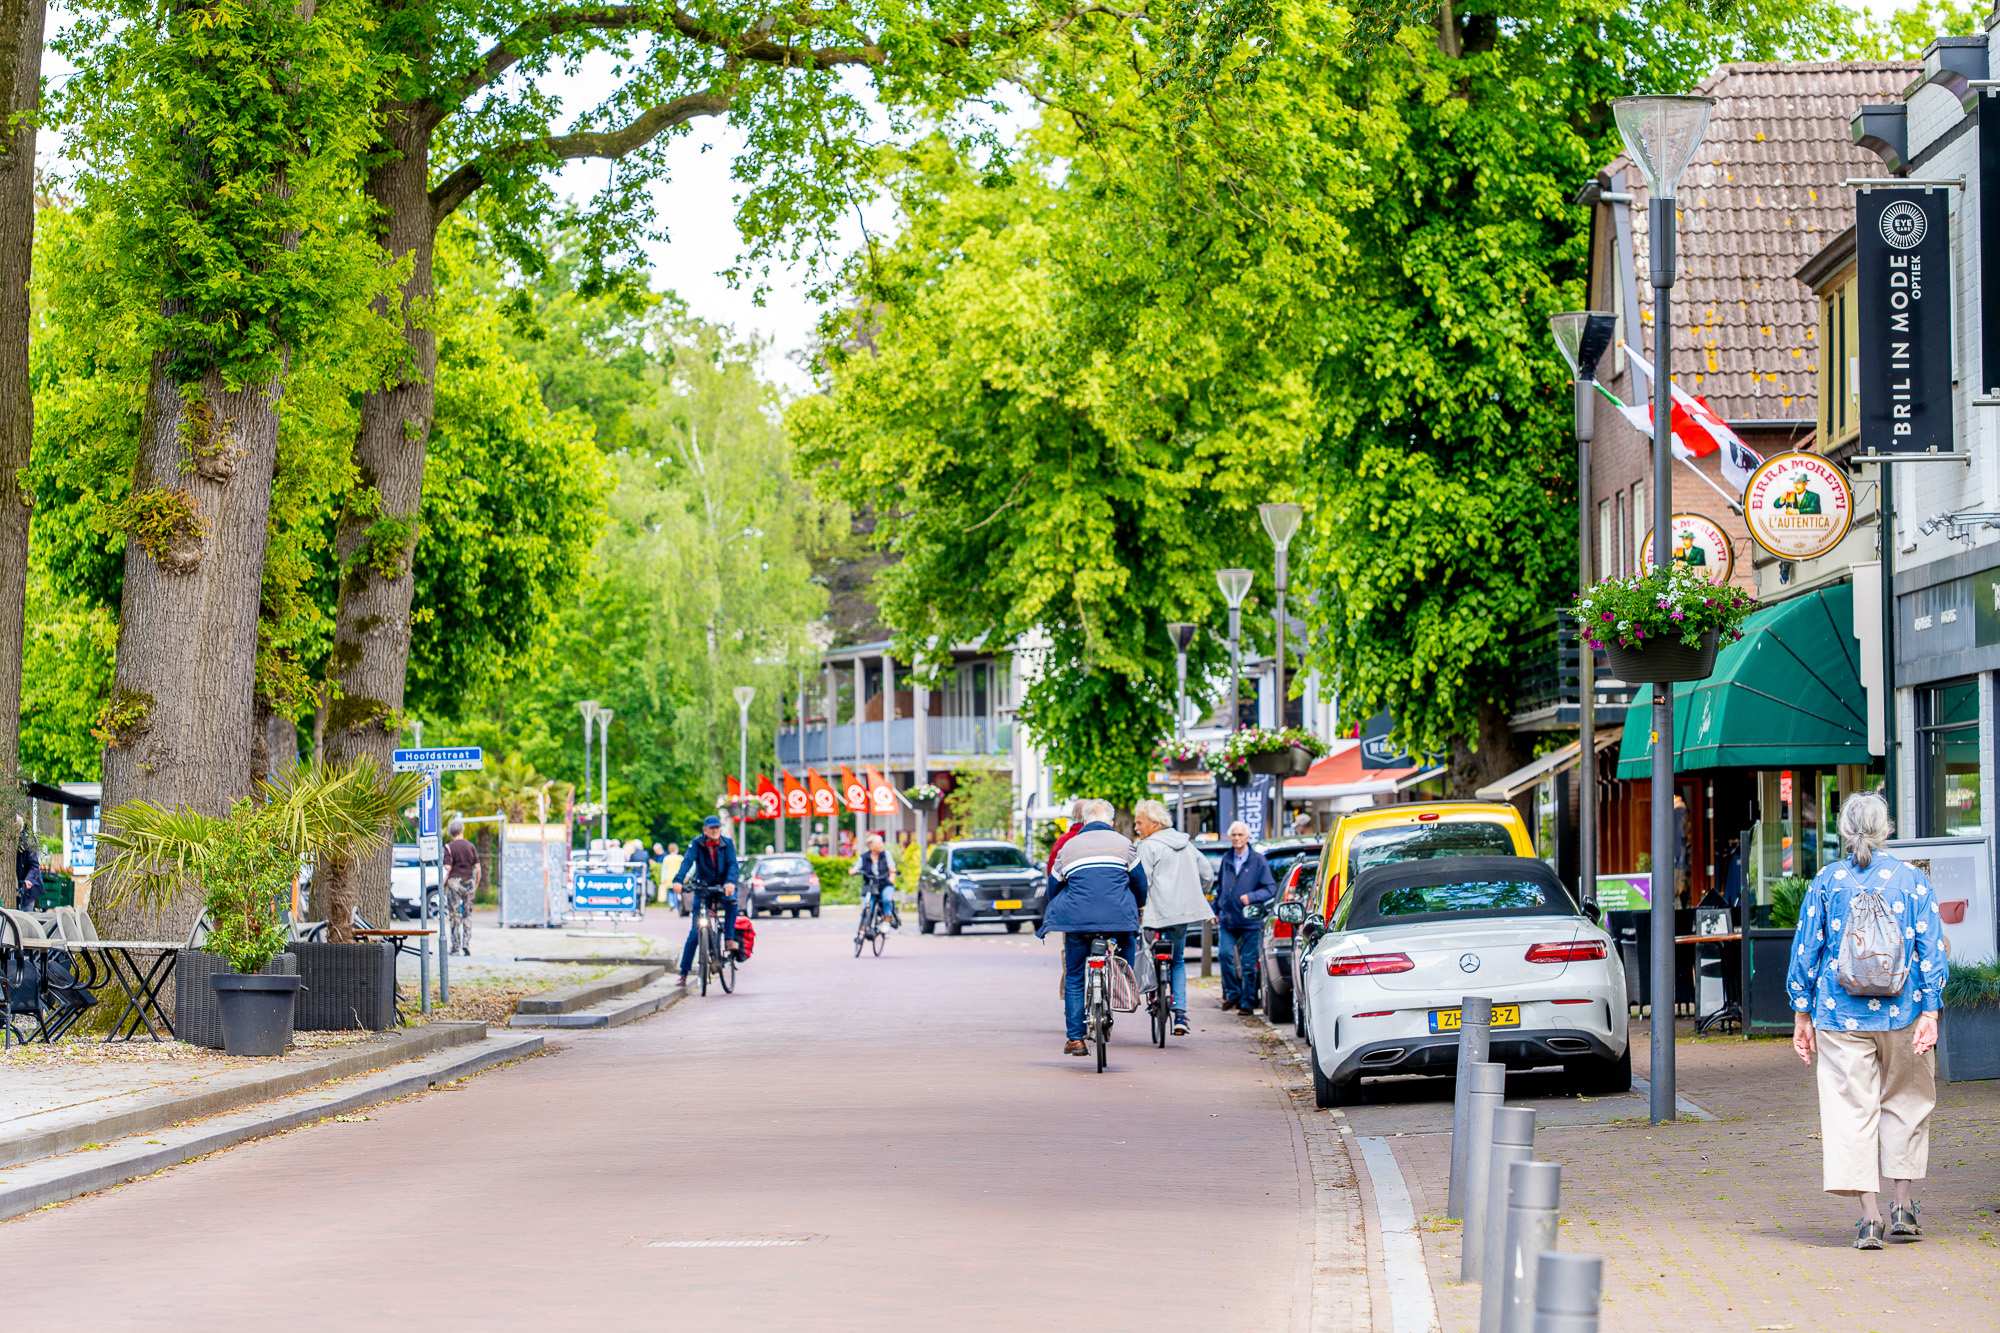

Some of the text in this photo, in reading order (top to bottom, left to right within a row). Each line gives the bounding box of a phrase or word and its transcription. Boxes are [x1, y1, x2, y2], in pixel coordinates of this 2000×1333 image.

[1894, 219, 1912, 227] EYE
[1890, 255, 1909, 333] MODE
[1911, 255, 1922, 300] OPTIEK
[1891, 342, 1910, 369] IN
[1892, 378, 1912, 436] BRIL
[1752, 459, 1846, 510] BIRRA MORETTI
[1769, 516, 1830, 528] L'AUTENTICA
[1680, 520, 1727, 562] MORETTI
[405, 751, 470, 760] Hoofdstraat
[587, 881, 624, 891] Asperges
